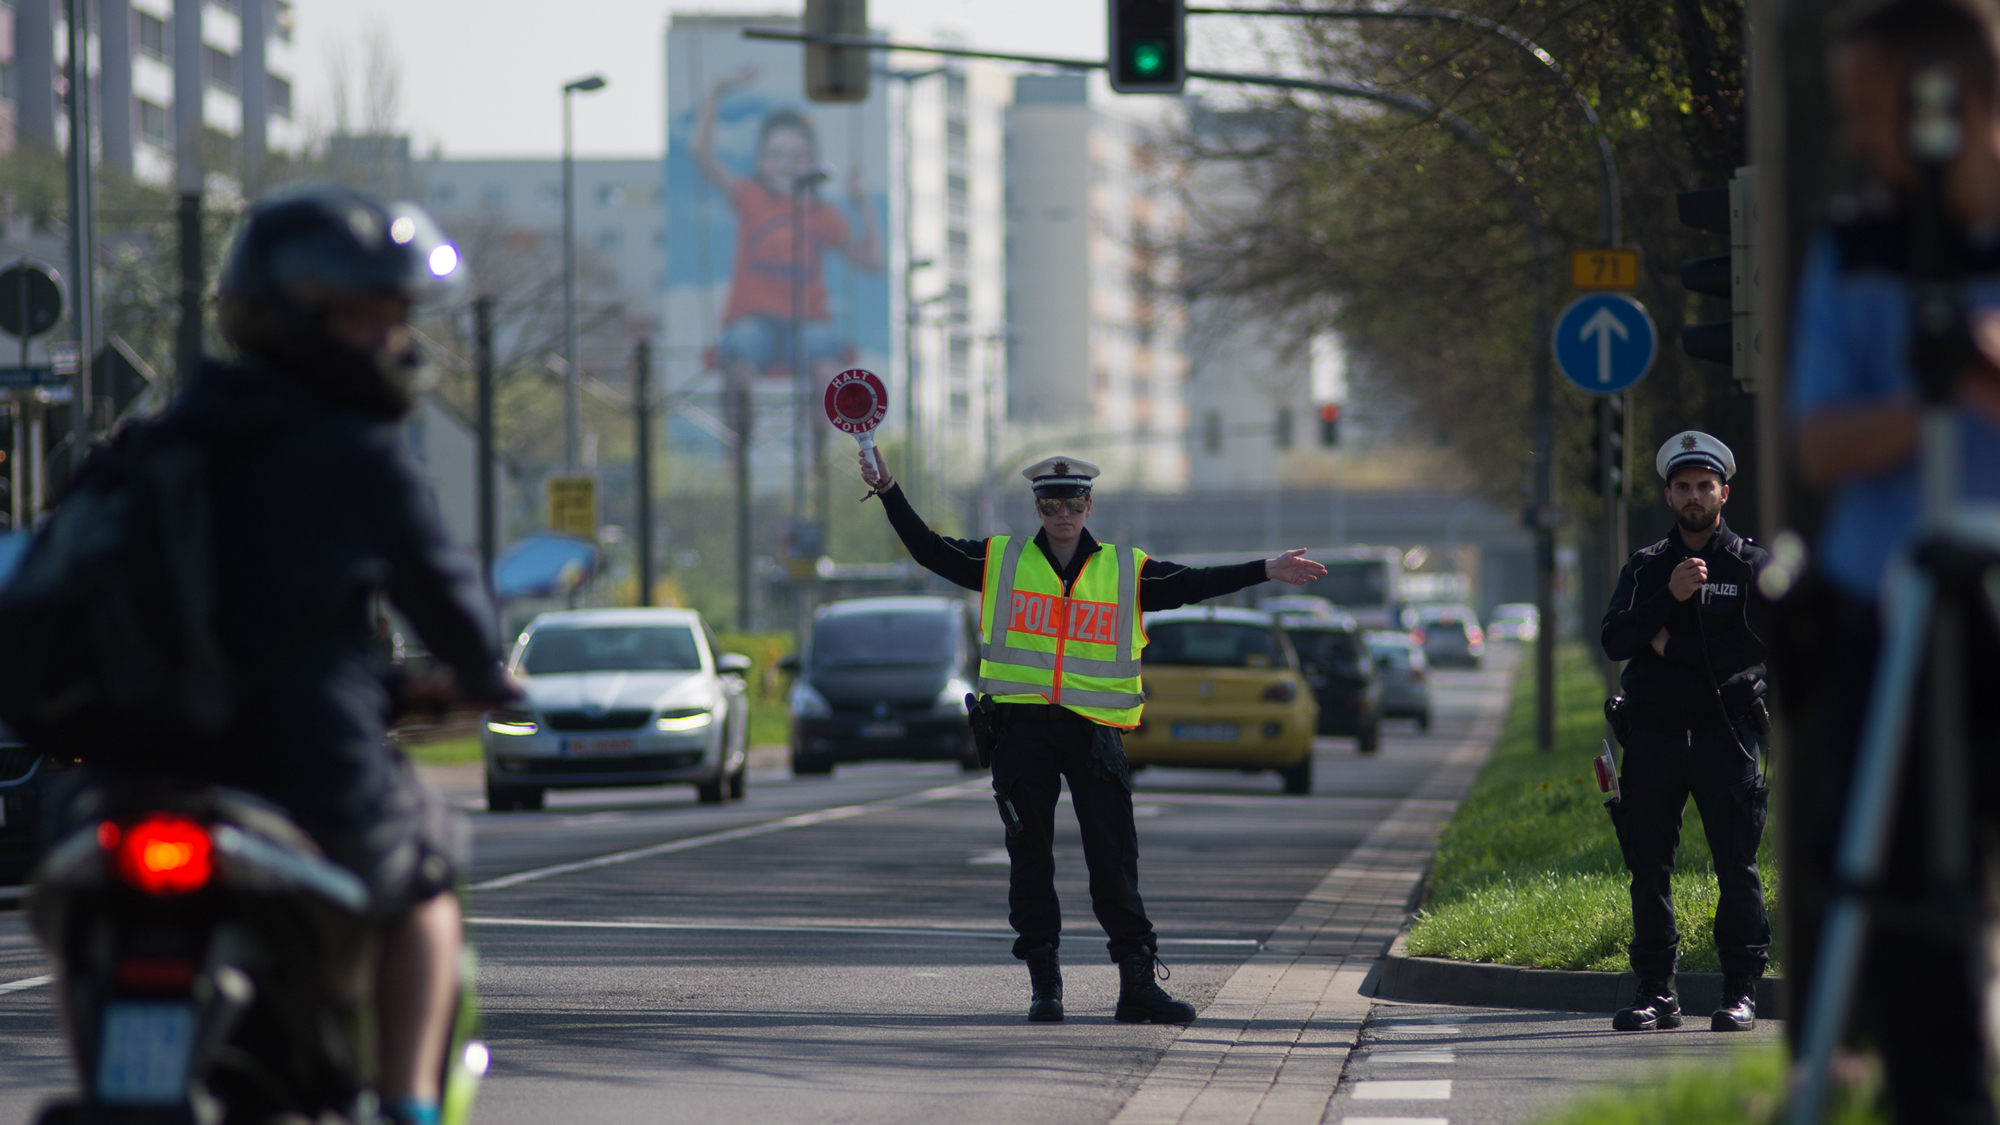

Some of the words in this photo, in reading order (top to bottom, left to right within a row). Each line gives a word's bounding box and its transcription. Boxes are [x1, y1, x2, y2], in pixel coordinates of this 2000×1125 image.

[1590, 256, 1619, 281] 71
[832, 370, 869, 388] HALT
[833, 405, 886, 433] POLIZEI
[1703, 583, 1737, 596] POLIZEI
[1009, 592, 1117, 642] POLIZEI
